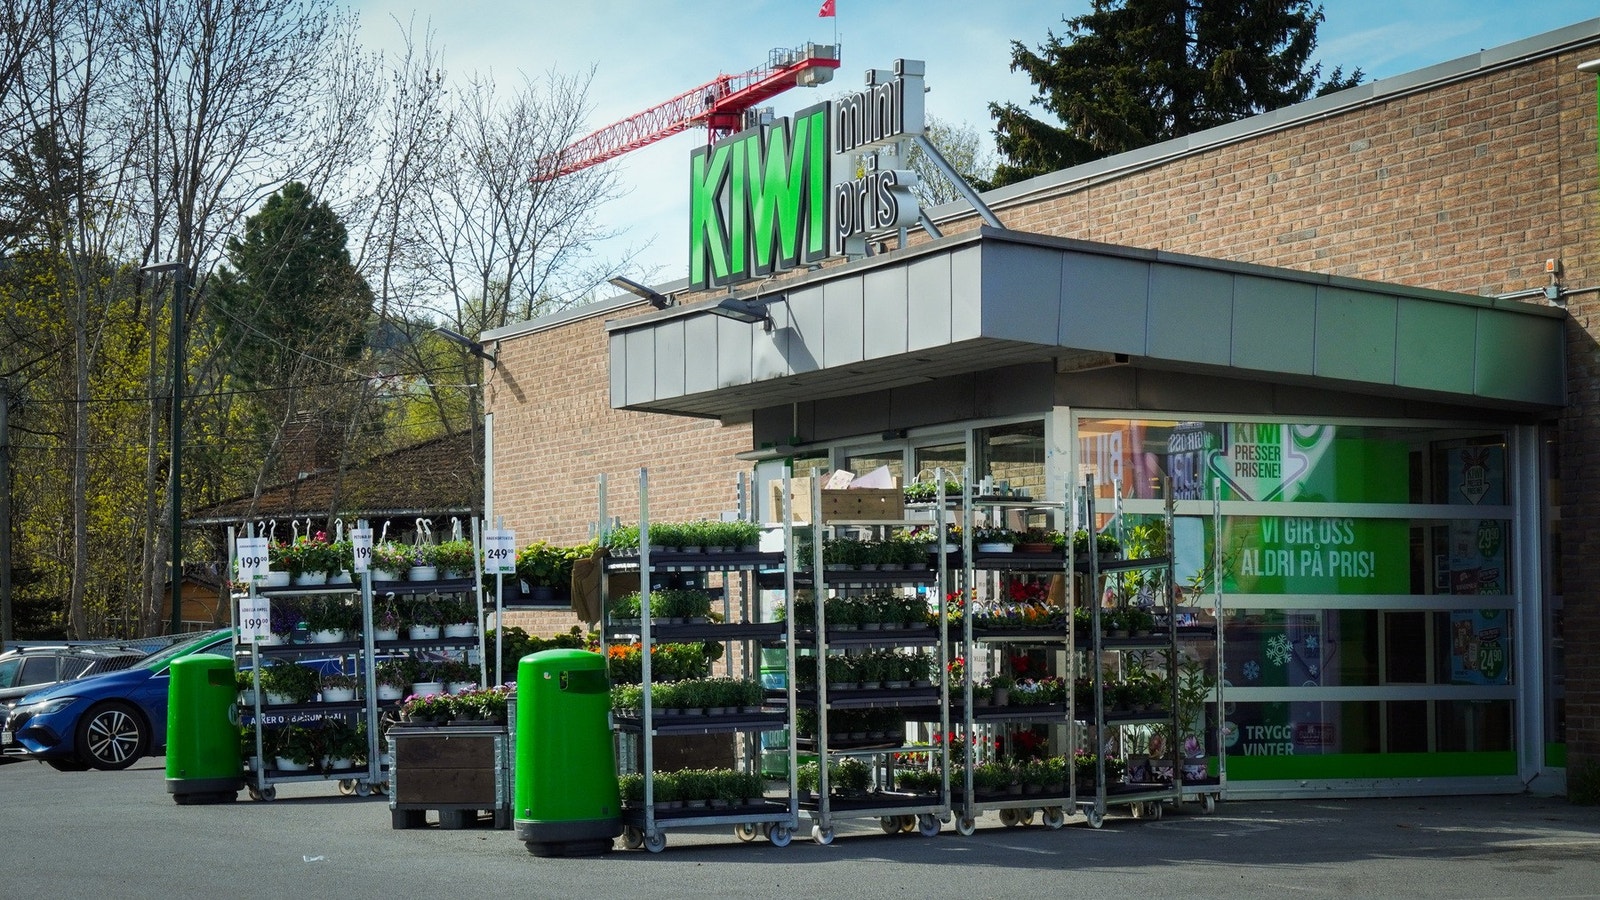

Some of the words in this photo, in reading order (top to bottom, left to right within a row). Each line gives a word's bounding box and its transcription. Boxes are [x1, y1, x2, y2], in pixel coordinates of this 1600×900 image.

[835, 59, 903, 154] mini
[690, 101, 831, 290] KIWI
[835, 155, 898, 255] pris
[1235, 423, 1280, 443] KIWI
[1235, 445, 1280, 461] PRESSER
[1235, 462, 1281, 478] PRISENE!
[1261, 517, 1278, 543] VI
[1284, 519, 1313, 543] GIR
[1319, 518, 1354, 544] OSS
[488, 549, 507, 559] 249
[1241, 550, 1294, 576] ALDRI
[1300, 543, 1323, 577] PÅ
[1329, 551, 1375, 577] PRIS!
[242, 557, 260, 568] 199
[245, 619, 261, 629] 199
[1481, 650, 1494, 670] 24
[250, 714, 276, 725] AKER
[1246, 726, 1291, 740] TRYGG
[1243, 743, 1294, 756] VINTER
